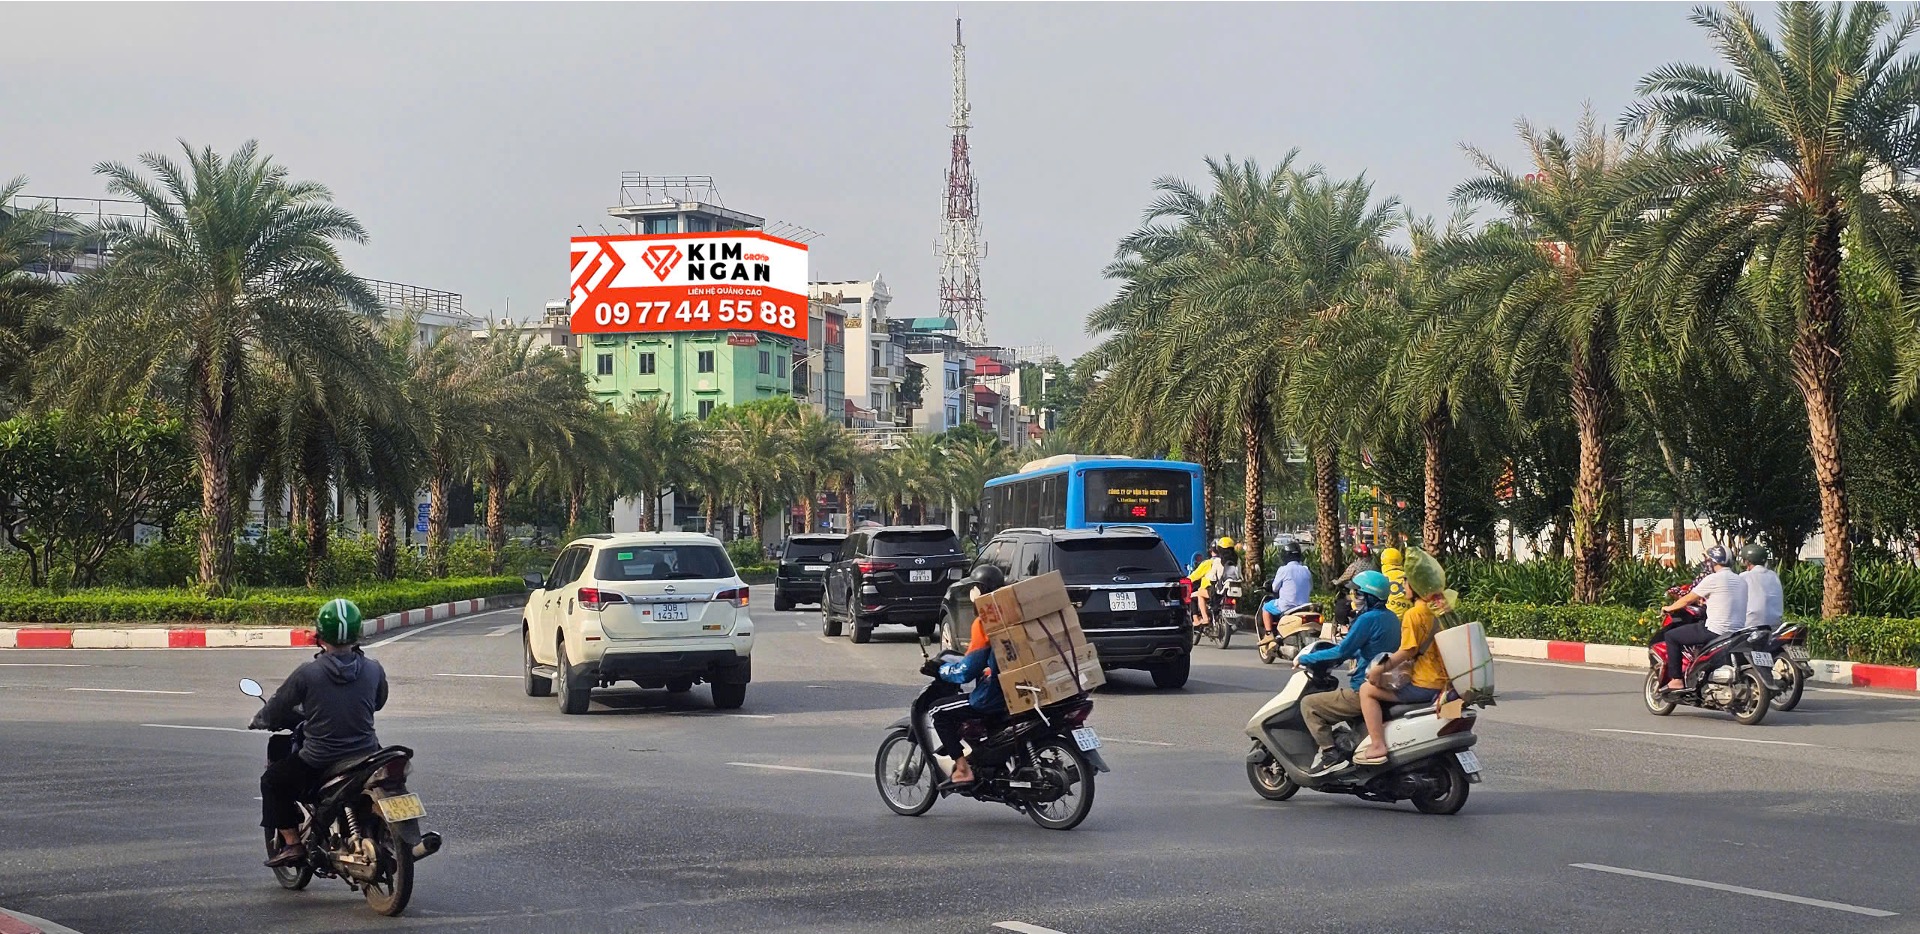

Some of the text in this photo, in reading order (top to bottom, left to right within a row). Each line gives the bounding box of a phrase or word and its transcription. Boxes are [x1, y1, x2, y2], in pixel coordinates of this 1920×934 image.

[688, 242, 742, 261] KIM
[688, 262, 770, 282] NGAN
[687, 287, 705, 296] LIÊN
[705, 287, 715, 296] HỆ
[717, 285, 744, 296] QUẢNG
[595, 299, 796, 329] 09 77 44 55 88
[1115, 592, 1130, 600] 99A
[658, 612, 684, 620] 143.71
